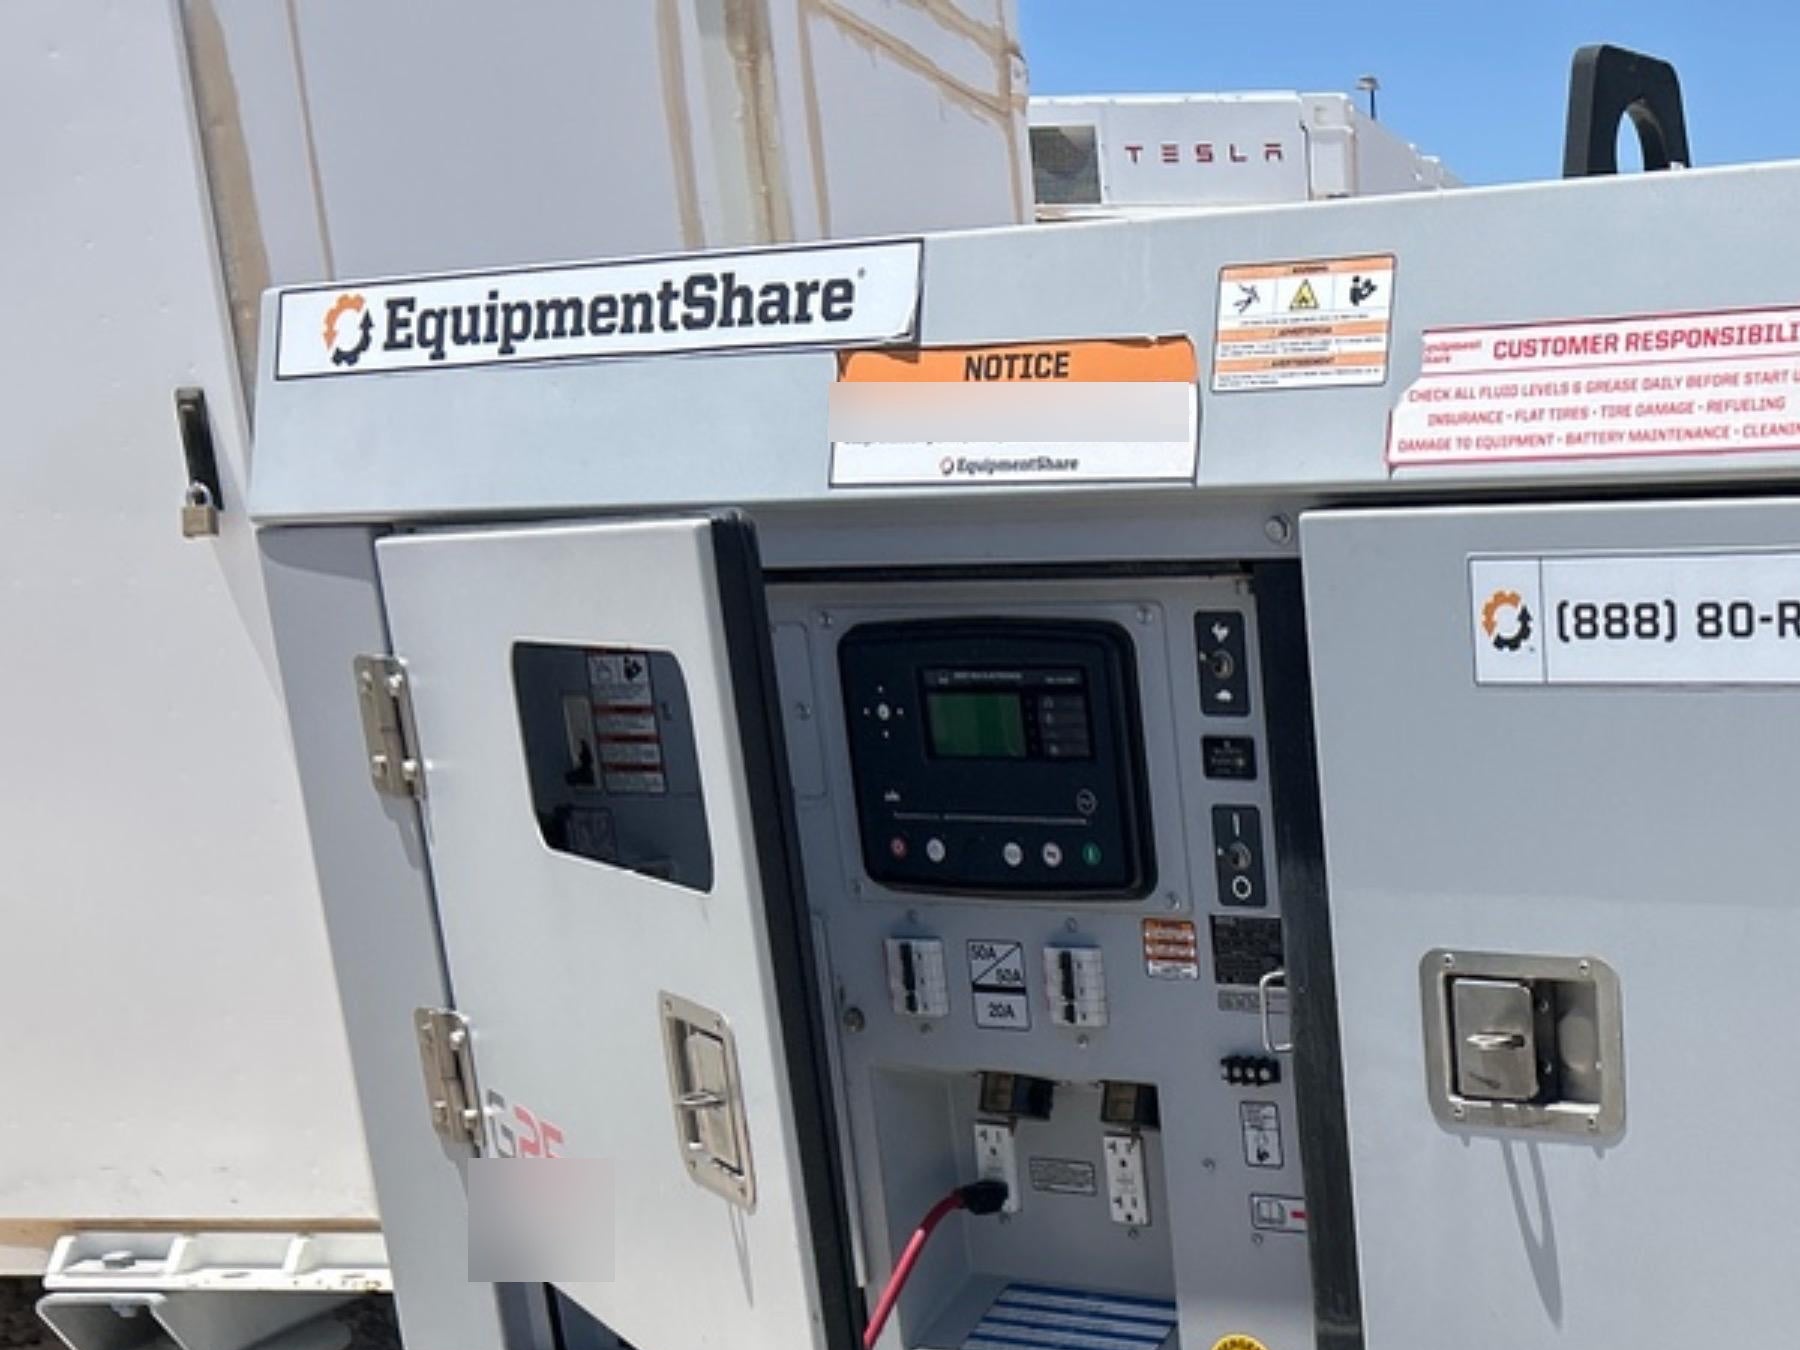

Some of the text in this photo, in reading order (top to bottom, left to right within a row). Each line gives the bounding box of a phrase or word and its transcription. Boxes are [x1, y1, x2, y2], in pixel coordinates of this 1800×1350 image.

[1124, 142, 1284, 165] TESLA
[382, 270, 856, 361] EquipmentShare
[1492, 332, 1620, 360] CUSTOMER
[964, 351, 1071, 381] NOTICE
[1409, 388, 1450, 402] CHECK
[1454, 387, 1476, 400] ALL
[1479, 385, 1519, 398] FLUID
[1521, 381, 1570, 397] LEVELS
[1586, 378, 1639, 393] GREASE
[1642, 375, 1683, 391] DAILY
[1685, 371, 1740, 389] BEFORE
[1743, 369, 1789, 386] START
[1427, 396, 1786, 427] INSURANCE FLAT TIRES TIRE DAMAGE REFUELING
[1398, 436, 1451, 453] DAMAGE
[1457, 436, 1473, 450] TO
[1476, 433, 1555, 449] EQUIPMENT
[1565, 429, 1625, 447] BATTERY
[1628, 425, 1730, 443] MAINTENANCE
[955, 456, 1079, 475] EquipmentShare
[1555, 600, 1677, 642] (888)
